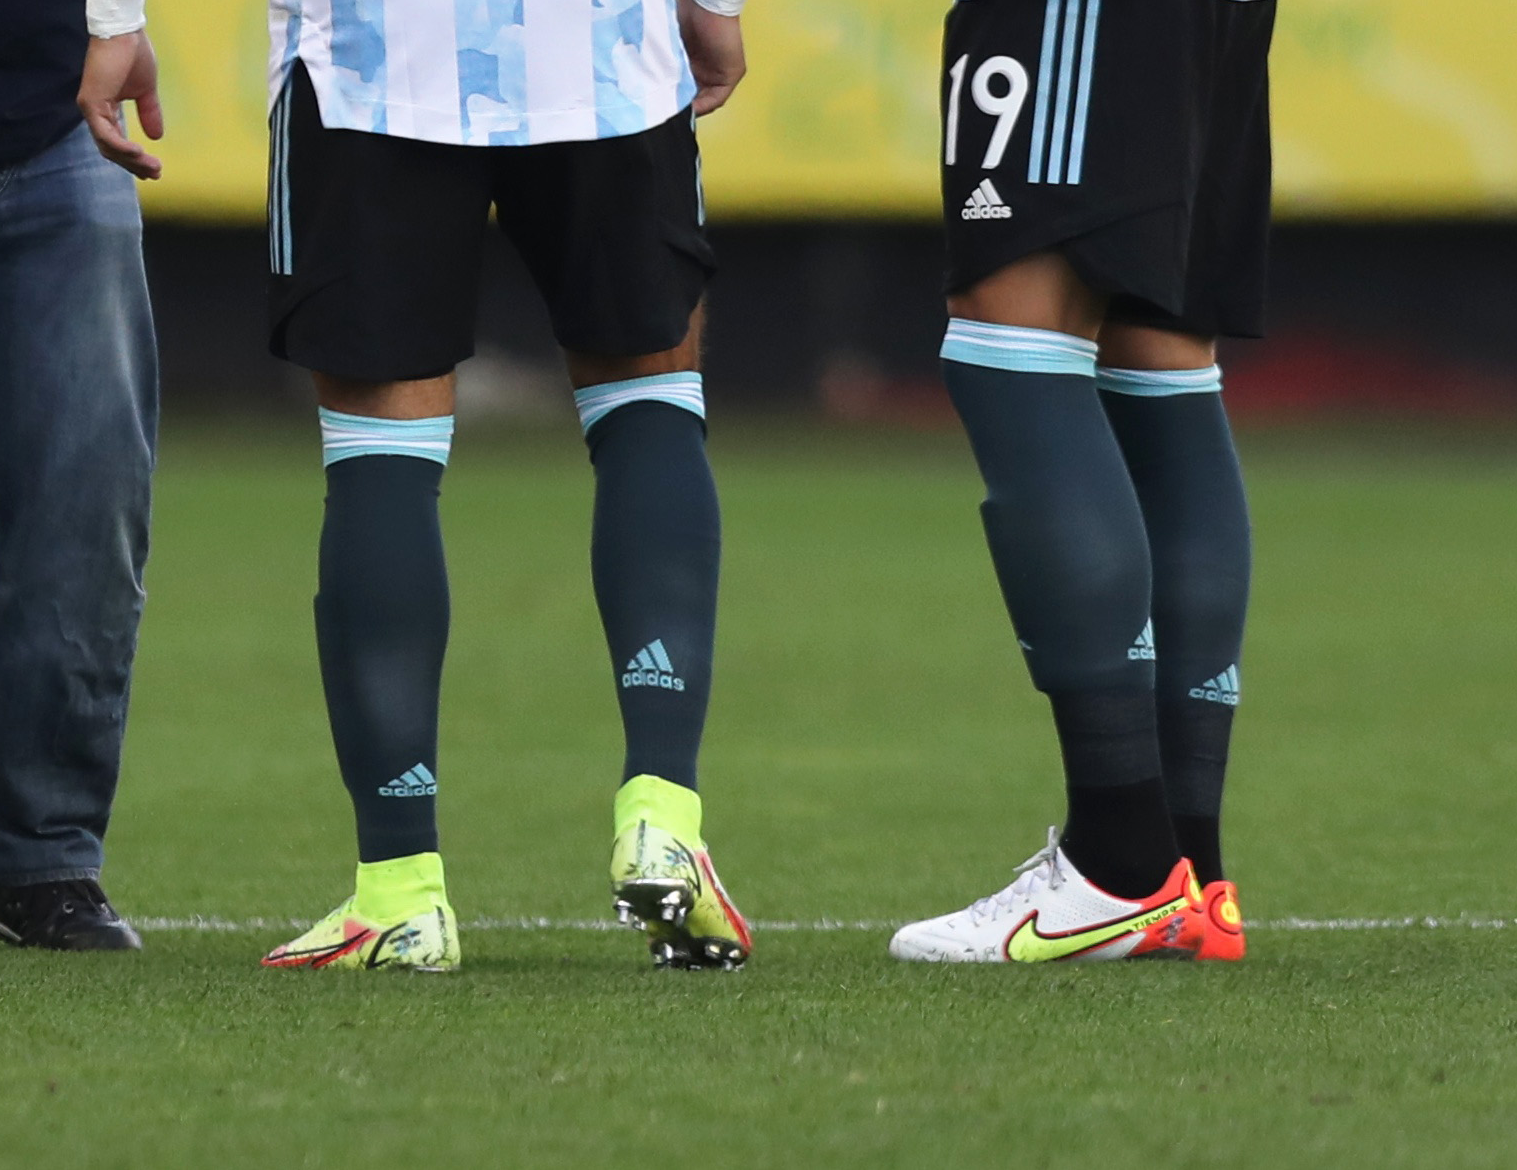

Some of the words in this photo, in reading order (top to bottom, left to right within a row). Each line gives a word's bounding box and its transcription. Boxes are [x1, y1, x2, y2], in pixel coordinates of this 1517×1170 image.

[945, 53, 1029, 170] 19
[960, 203, 1014, 221] adidas
[621, 668, 686, 692] adidas
[1188, 686, 1240, 706] adida
[377, 782, 438, 798] adida
